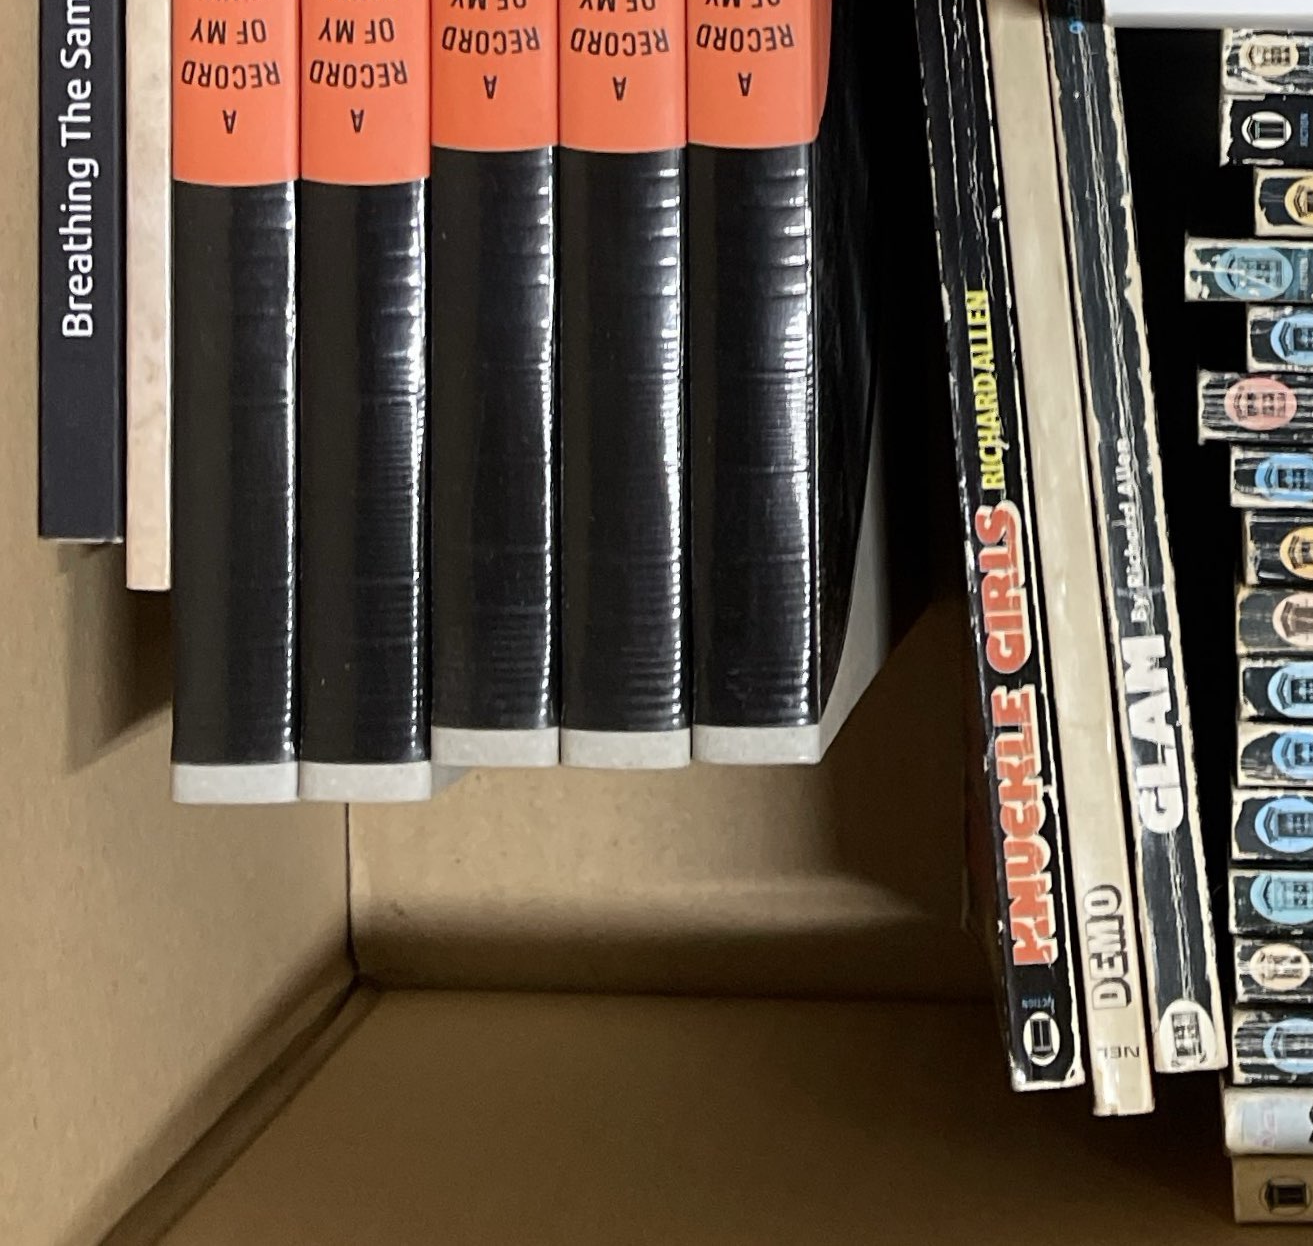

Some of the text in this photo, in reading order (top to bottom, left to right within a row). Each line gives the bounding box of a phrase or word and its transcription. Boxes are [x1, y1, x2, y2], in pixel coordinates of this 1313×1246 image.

[189, 17, 268, 45] OF MY
[318, 17, 395, 44] OF MY
[441, 25, 541, 55] RECORD
[570, 27, 670, 57] RECORD
[696, 23, 795, 53] RECORD
[181, 60, 281, 90] RECORD
[309, 59, 409, 89] RECORD
[483, 75, 498, 99] A
[612, 76, 627, 101] A
[738, 72, 753, 97] A
[57, 79, 92, 148] The
[222, 109, 237, 134] A
[350, 108, 365, 133] A
[58, 156, 99, 338] Breathing
[965, 290, 996, 374] ALLEN
[972, 373, 1006, 490] RICHARD
[975, 499, 1032, 674] GIRLS
[1121, 636, 1185, 834] GLAM
[991, 684, 1058, 967] KNUCKLE
[1083, 884, 1130, 1011] DEMO
